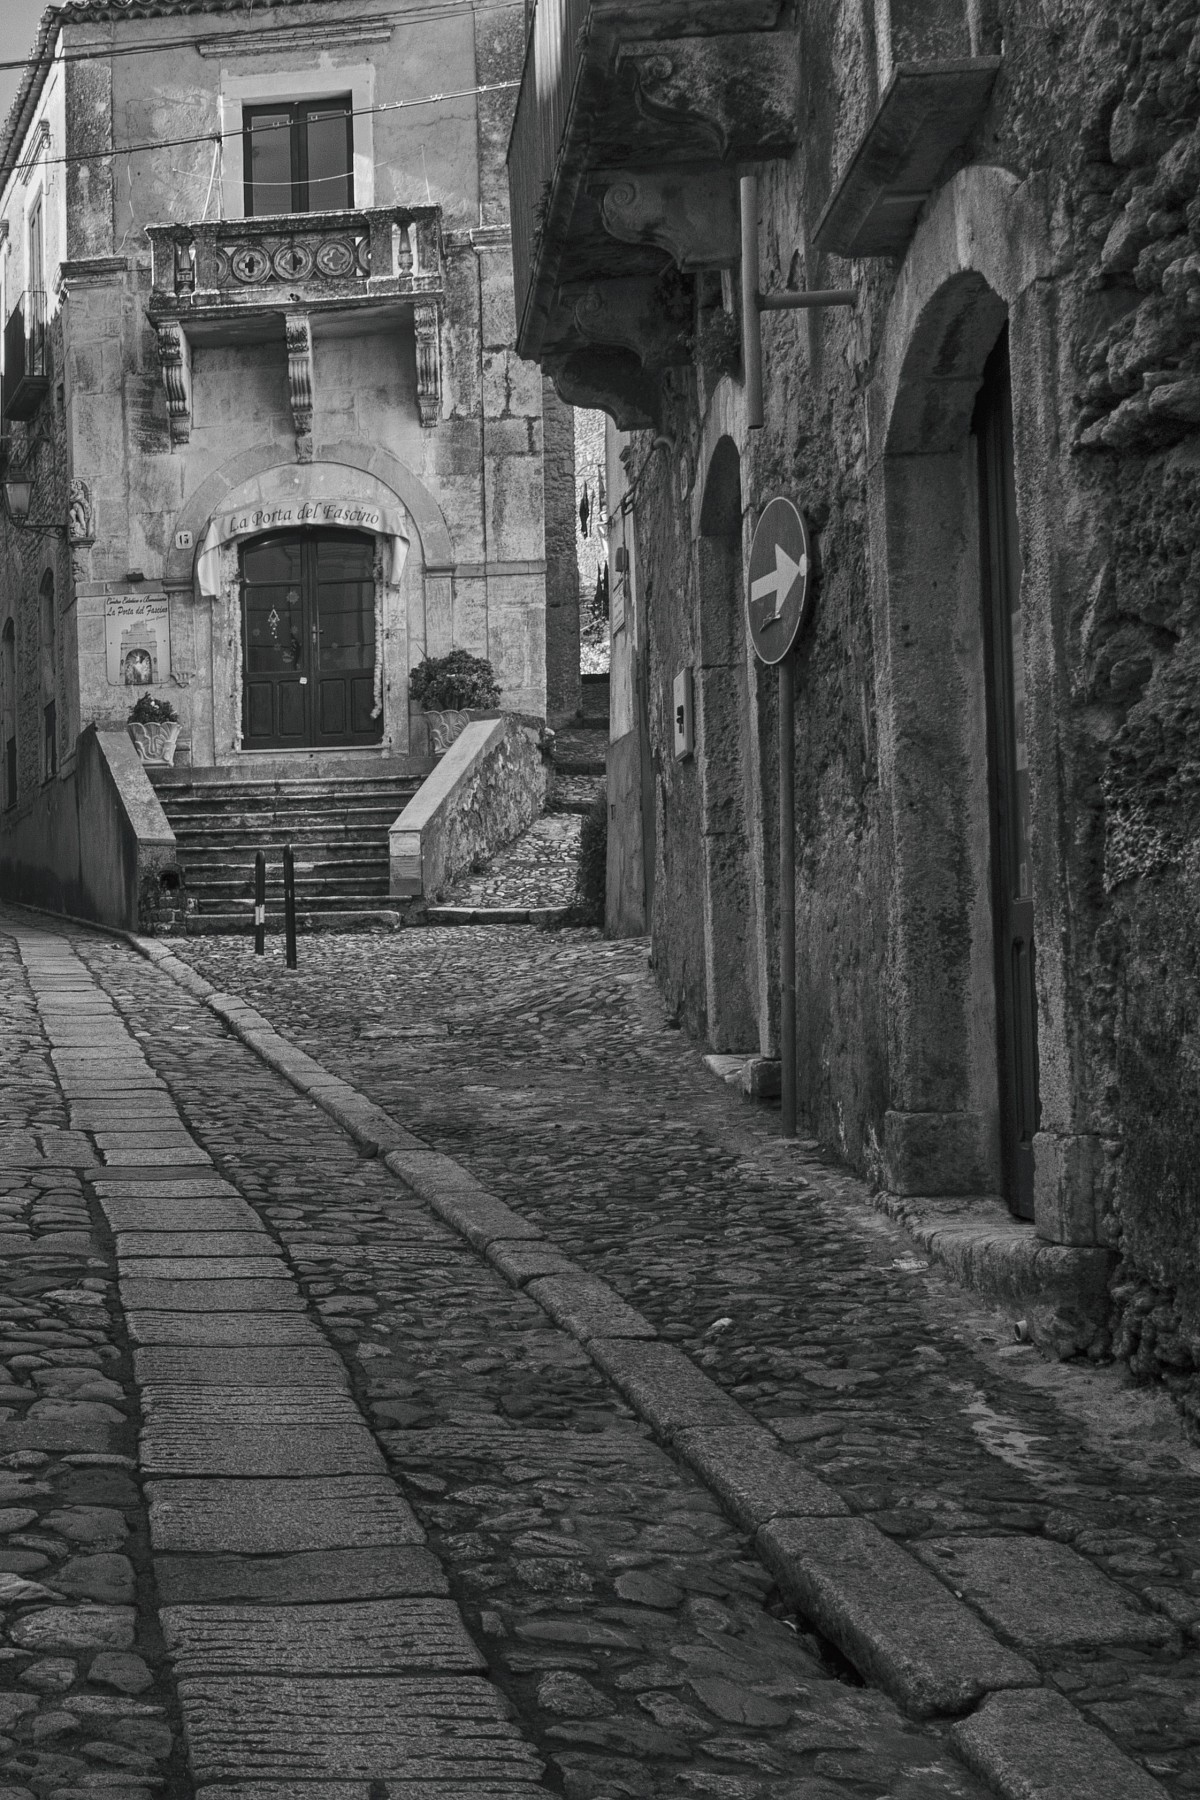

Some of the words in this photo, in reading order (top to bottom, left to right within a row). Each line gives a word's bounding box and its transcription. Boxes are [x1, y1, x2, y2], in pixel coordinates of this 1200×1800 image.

[230, 517, 248, 533] La
[252, 508, 292, 526] Porta
[297, 502, 322, 520] del
[323, 504, 380, 525] Fascino
[106, 606, 115, 616] La
[118, 606, 133, 616] Porta
[136, 605, 145, 614] del
[146, 604, 167, 616] Fascino
